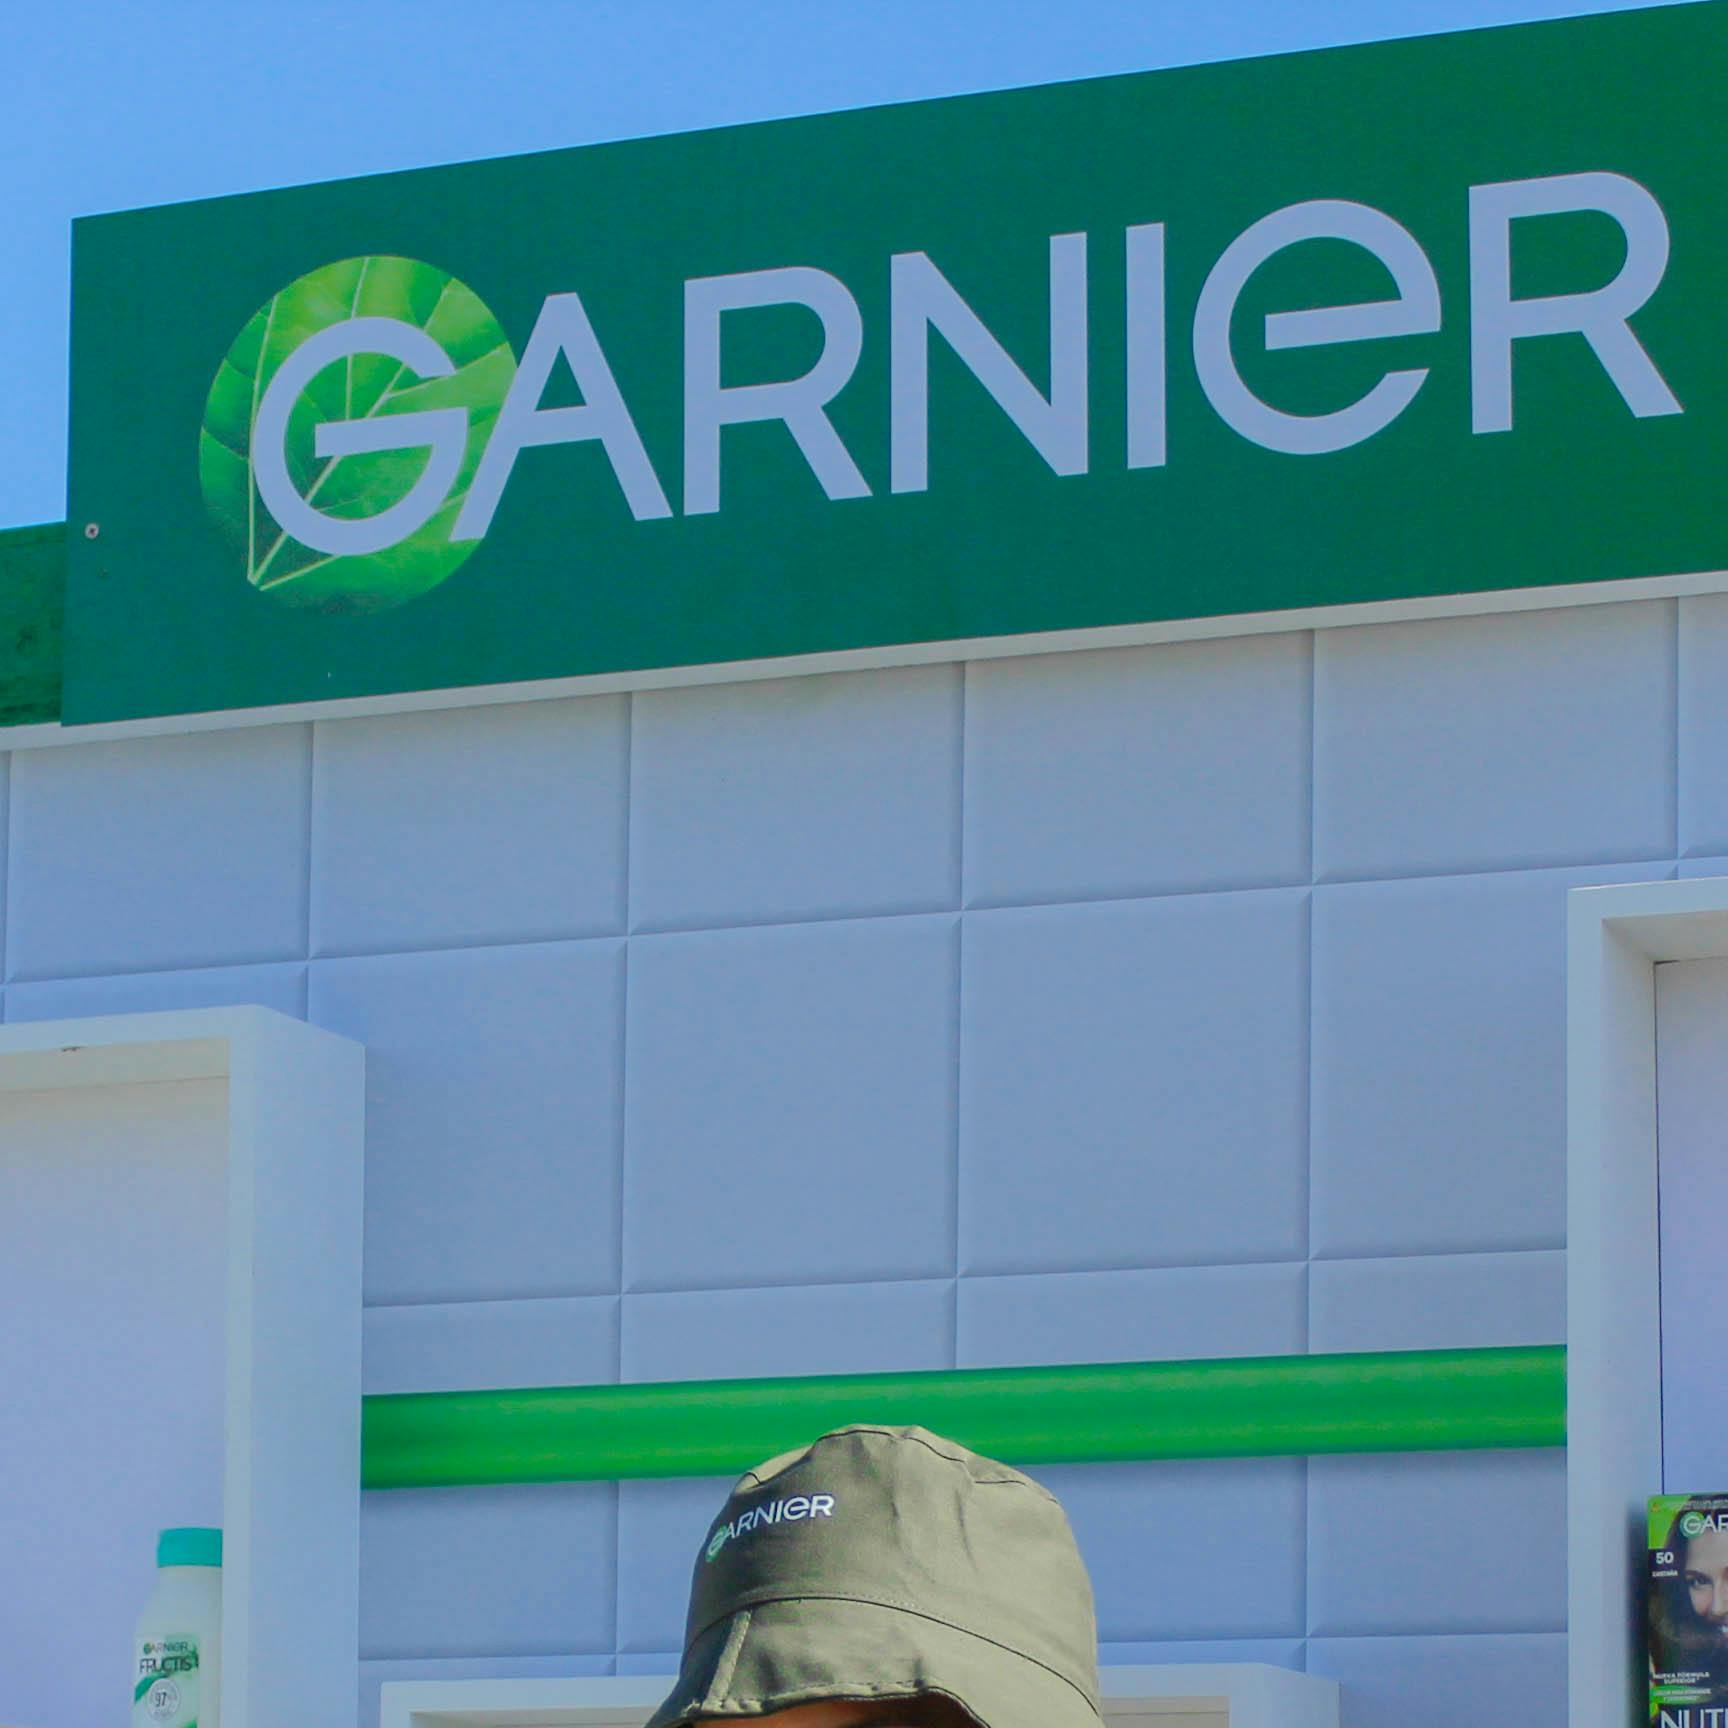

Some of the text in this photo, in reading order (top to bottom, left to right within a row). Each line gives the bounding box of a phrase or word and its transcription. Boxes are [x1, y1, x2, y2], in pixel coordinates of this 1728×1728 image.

[250, 170, 1684, 558] GARNIER
[707, 1494, 835, 1557] GARNIER
[1655, 1551, 1674, 1565] 50
[139, 1656, 192, 1673] FRUCTIS
